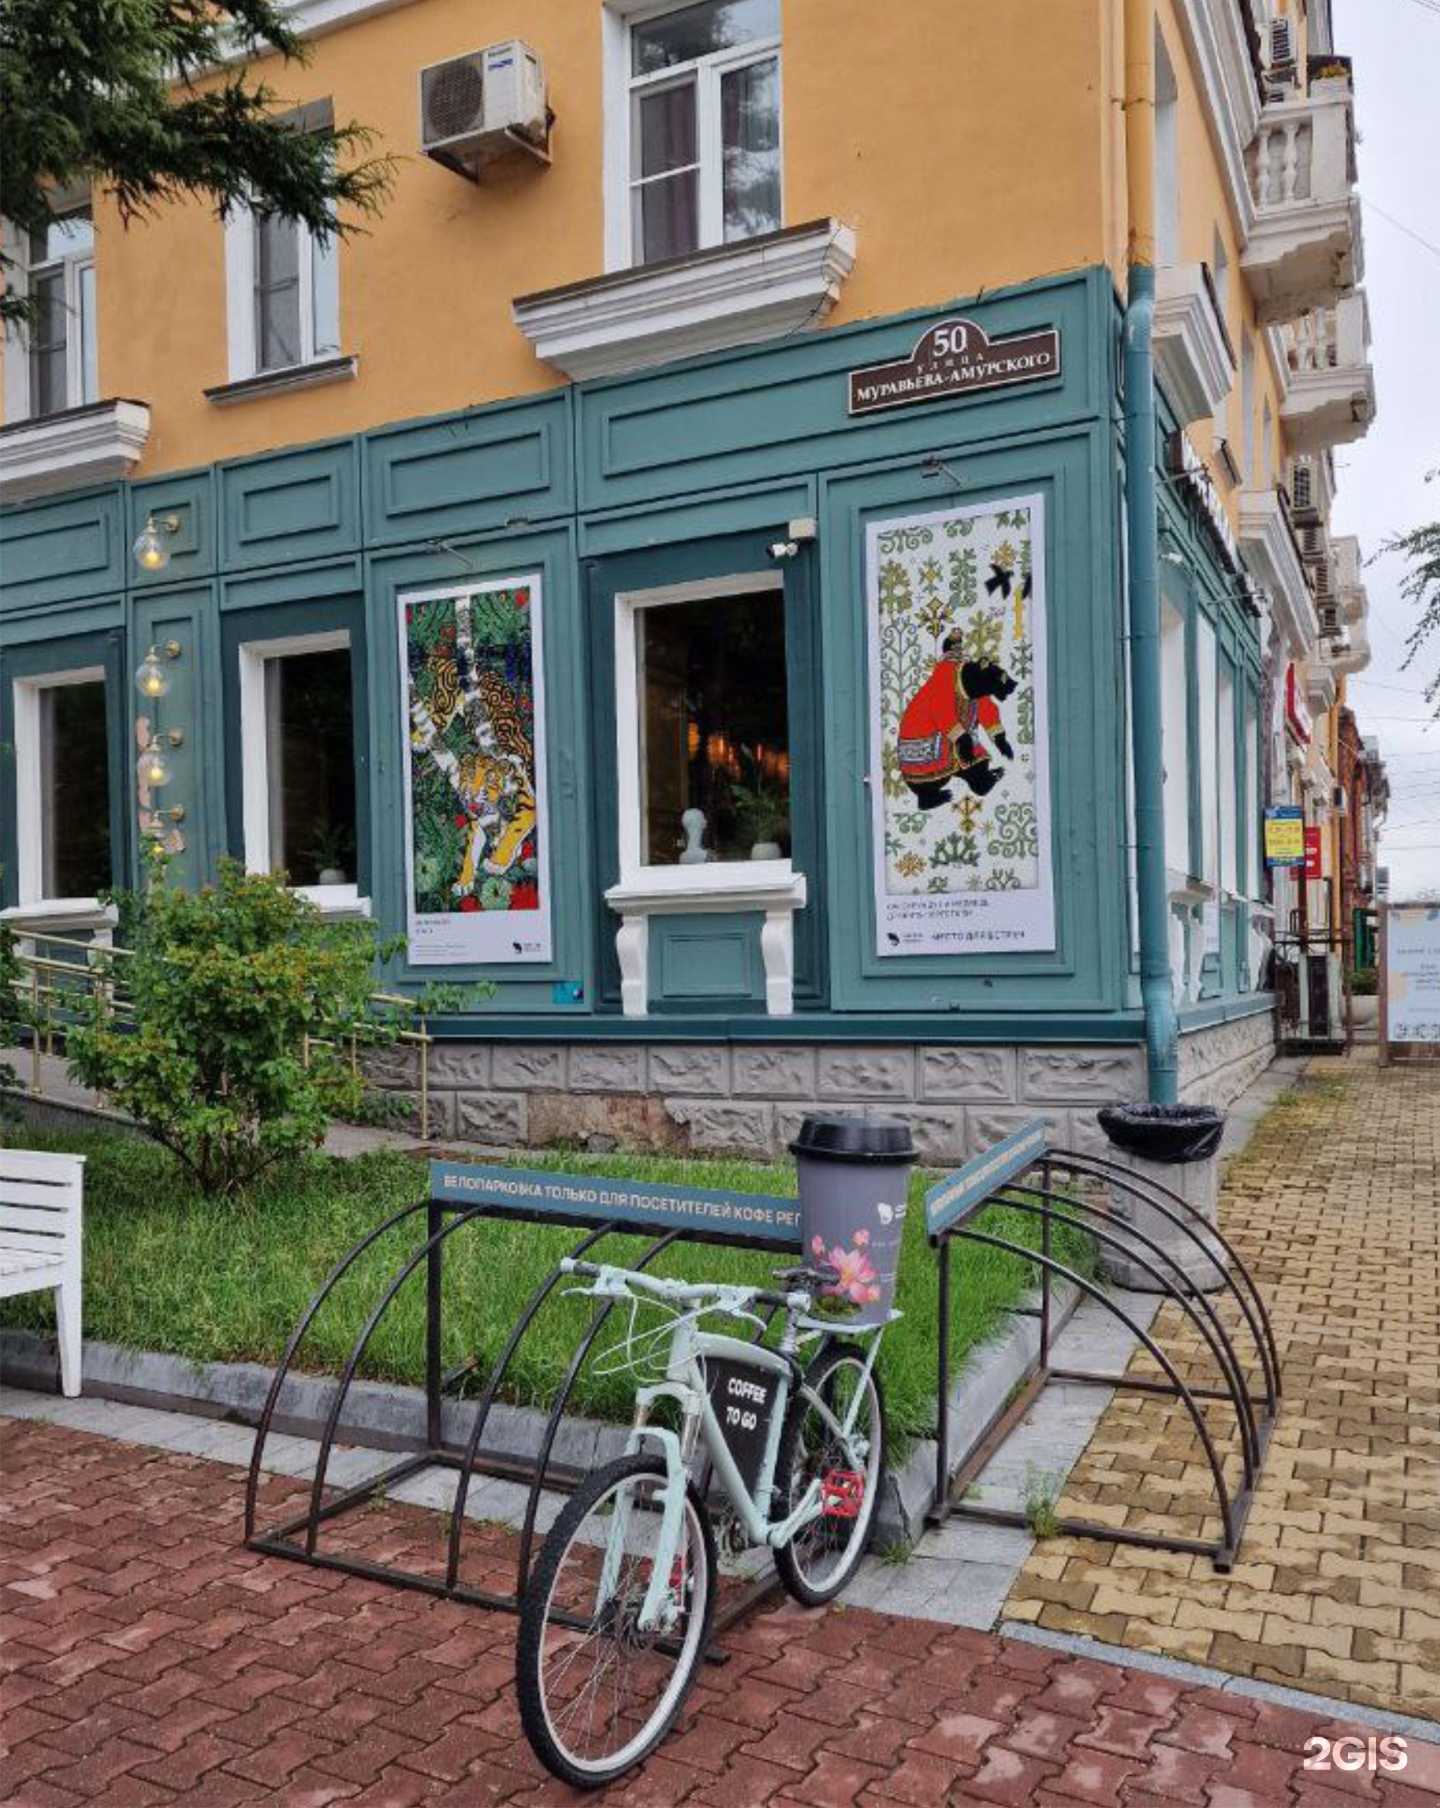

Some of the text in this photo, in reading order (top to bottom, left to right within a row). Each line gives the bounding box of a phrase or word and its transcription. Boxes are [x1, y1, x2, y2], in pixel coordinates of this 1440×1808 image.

[932, 326, 967, 356] 50
[444, 1175, 543, 1197] ВЕЛОПАРКОВКА
[544, 1186, 597, 1203] ТОЛЬКО
[599, 1191, 628, 1207] ДЛЯ
[630, 1194, 732, 1218] ПОСЕТИТЕЛЕЙ
[734, 1207, 773, 1223] КОФЕ
[727, 1377, 767, 1404] COFFEE
[726, 1406, 757, 1431] TO GO
